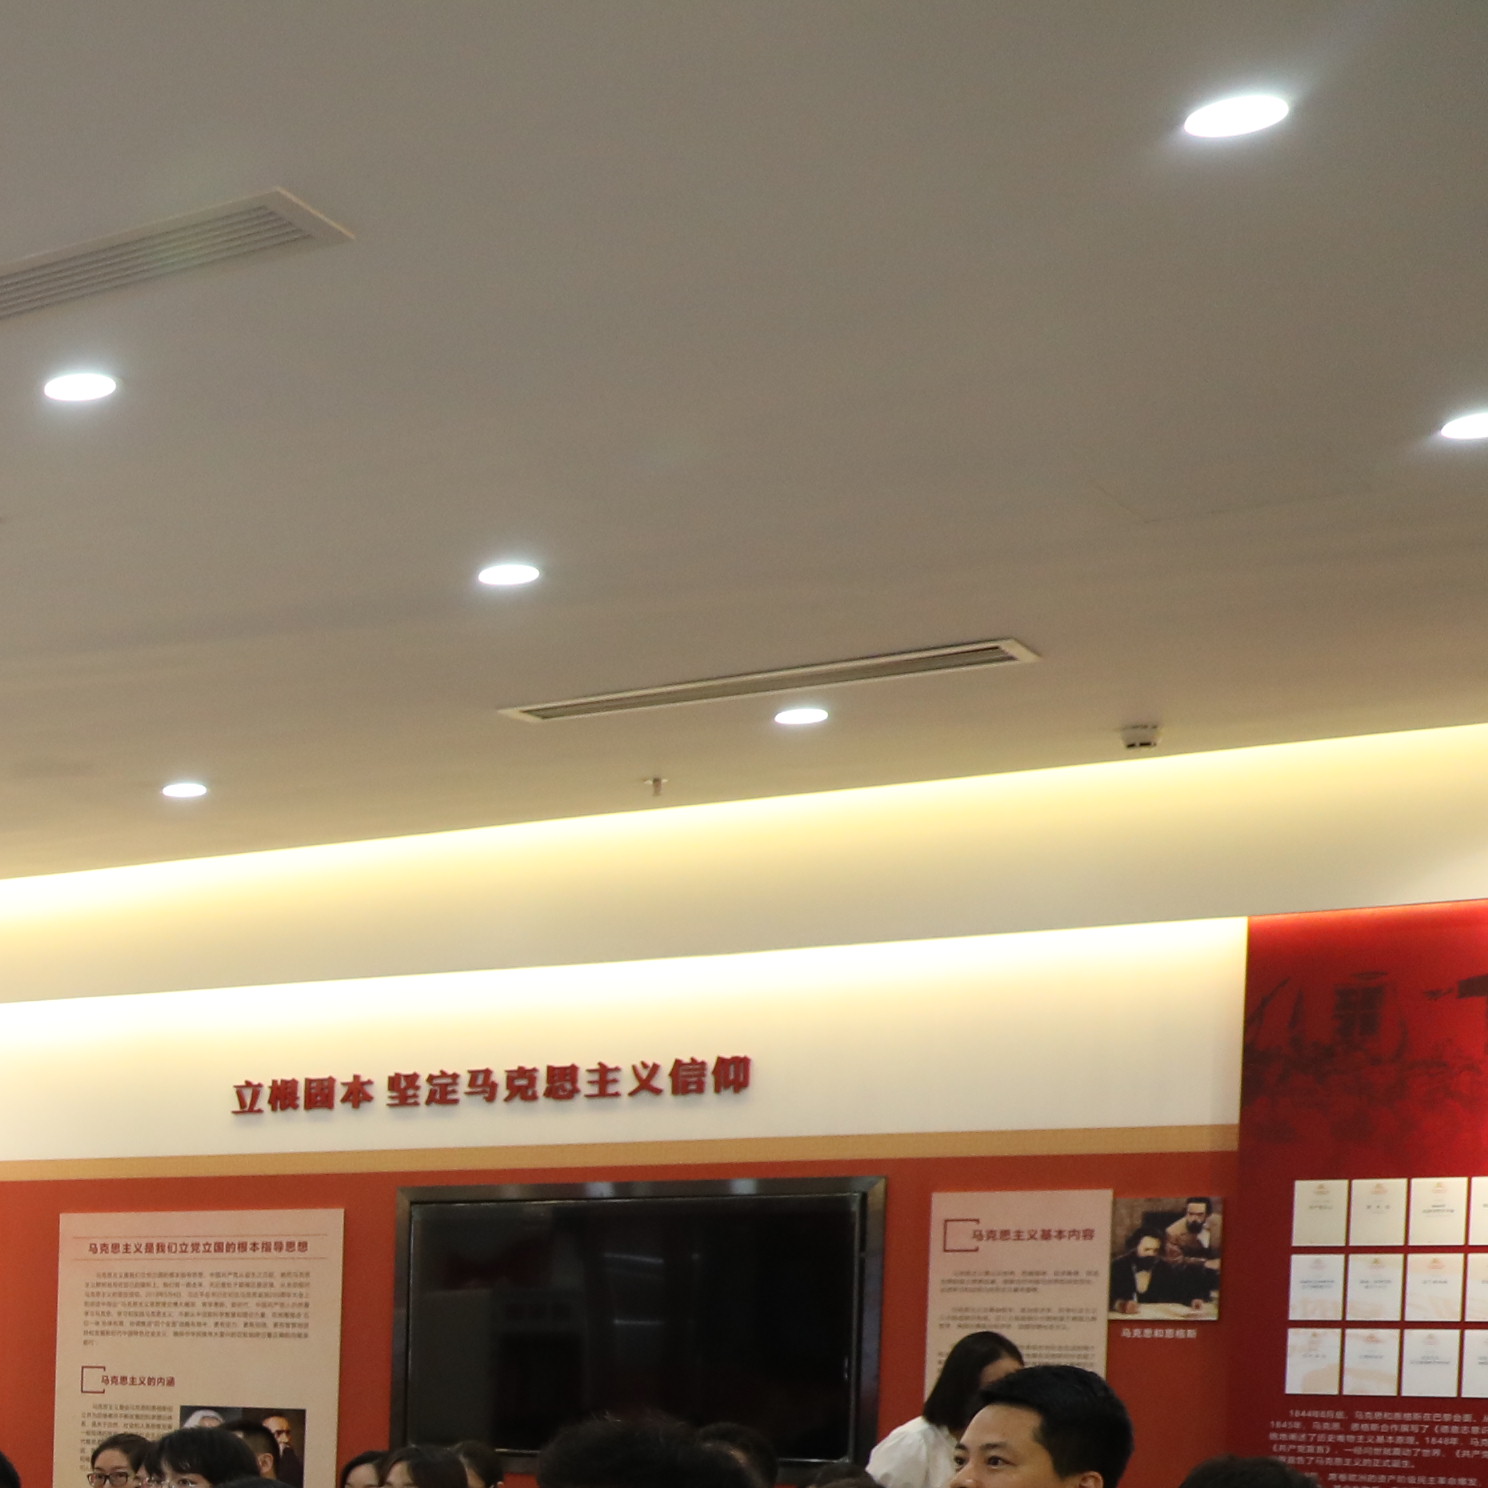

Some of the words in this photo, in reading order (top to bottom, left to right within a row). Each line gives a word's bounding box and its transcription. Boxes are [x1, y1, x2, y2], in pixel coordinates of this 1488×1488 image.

[231, 1074, 375, 1115] 立根固本
[385, 1055, 752, 1109] 坚定马克思主义信仰
[972, 1228, 1095, 1242] 马克思主义基本内容
[88, 1240, 309, 1254] 马克思主义是我们立党立国的根本指导思想
[101, 1375, 176, 1387] 马克思主义的内涵
